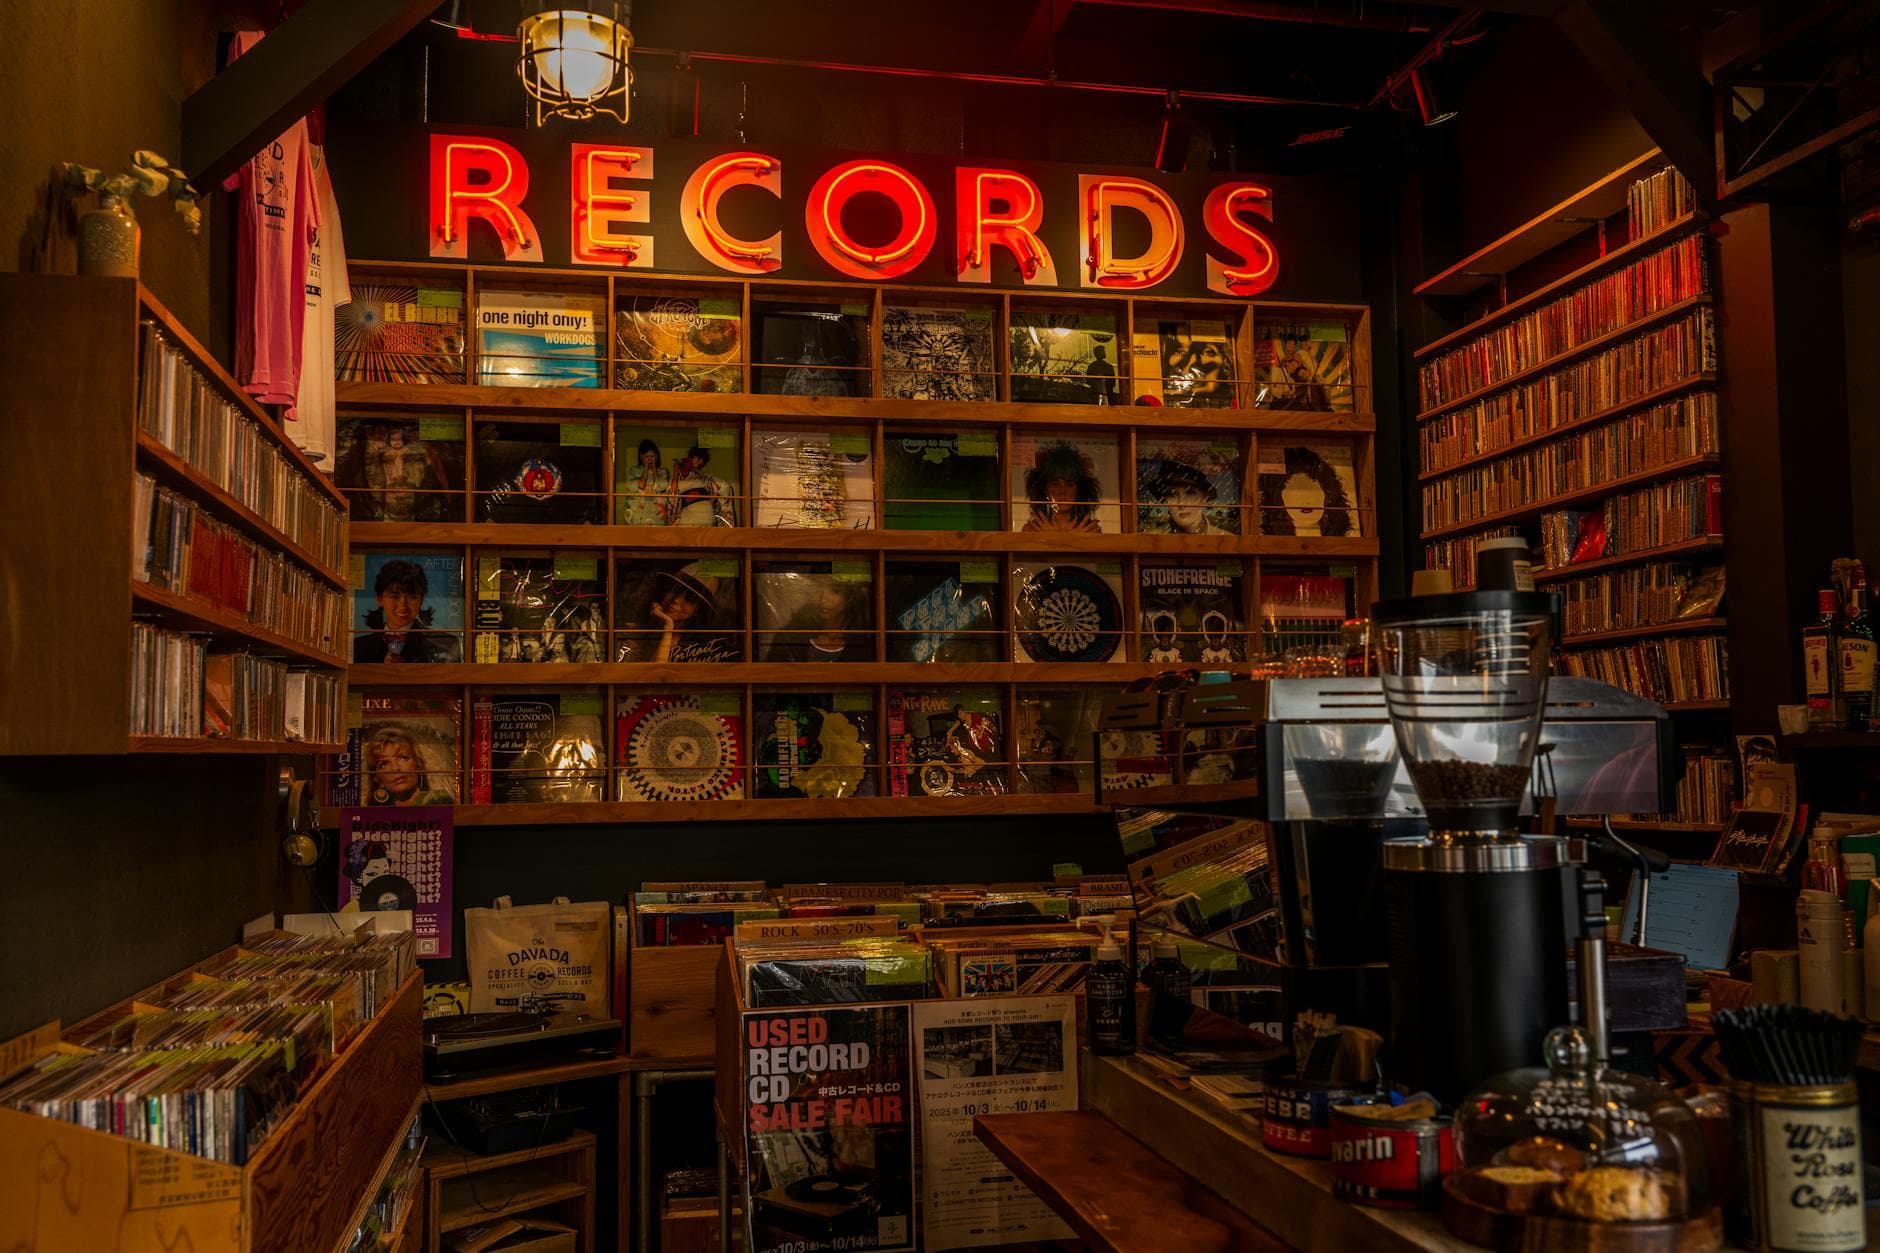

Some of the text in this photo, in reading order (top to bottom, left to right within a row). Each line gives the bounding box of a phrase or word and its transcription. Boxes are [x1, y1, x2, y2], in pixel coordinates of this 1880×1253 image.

[429, 133, 1281, 297] RECORDS
[482, 310, 587, 330] one night only!
[544, 333, 597, 346] WORKDOGS
[921, 696, 950, 713] RAVE
[512, 713, 552, 721] CONDON
[514, 722, 538, 730] STARS
[775, 709, 790, 765] INFLUENCE
[787, 887, 901, 898] JAPANESE CITY POP
[761, 922, 875, 938] ROCK 50'S-70'S
[507, 948, 570, 966] DAVADA
[488, 965, 593, 980] COFFEE RECORDS
[749, 1017, 829, 1048] USED
[749, 1042, 870, 1076] RECORD
[749, 1075, 790, 1105] CD
[818, 1083, 901, 1097] 中古レコード&CD
[750, 1095, 903, 1133] SALE FAIR
[1791, 1184, 1858, 1214] Coffee
